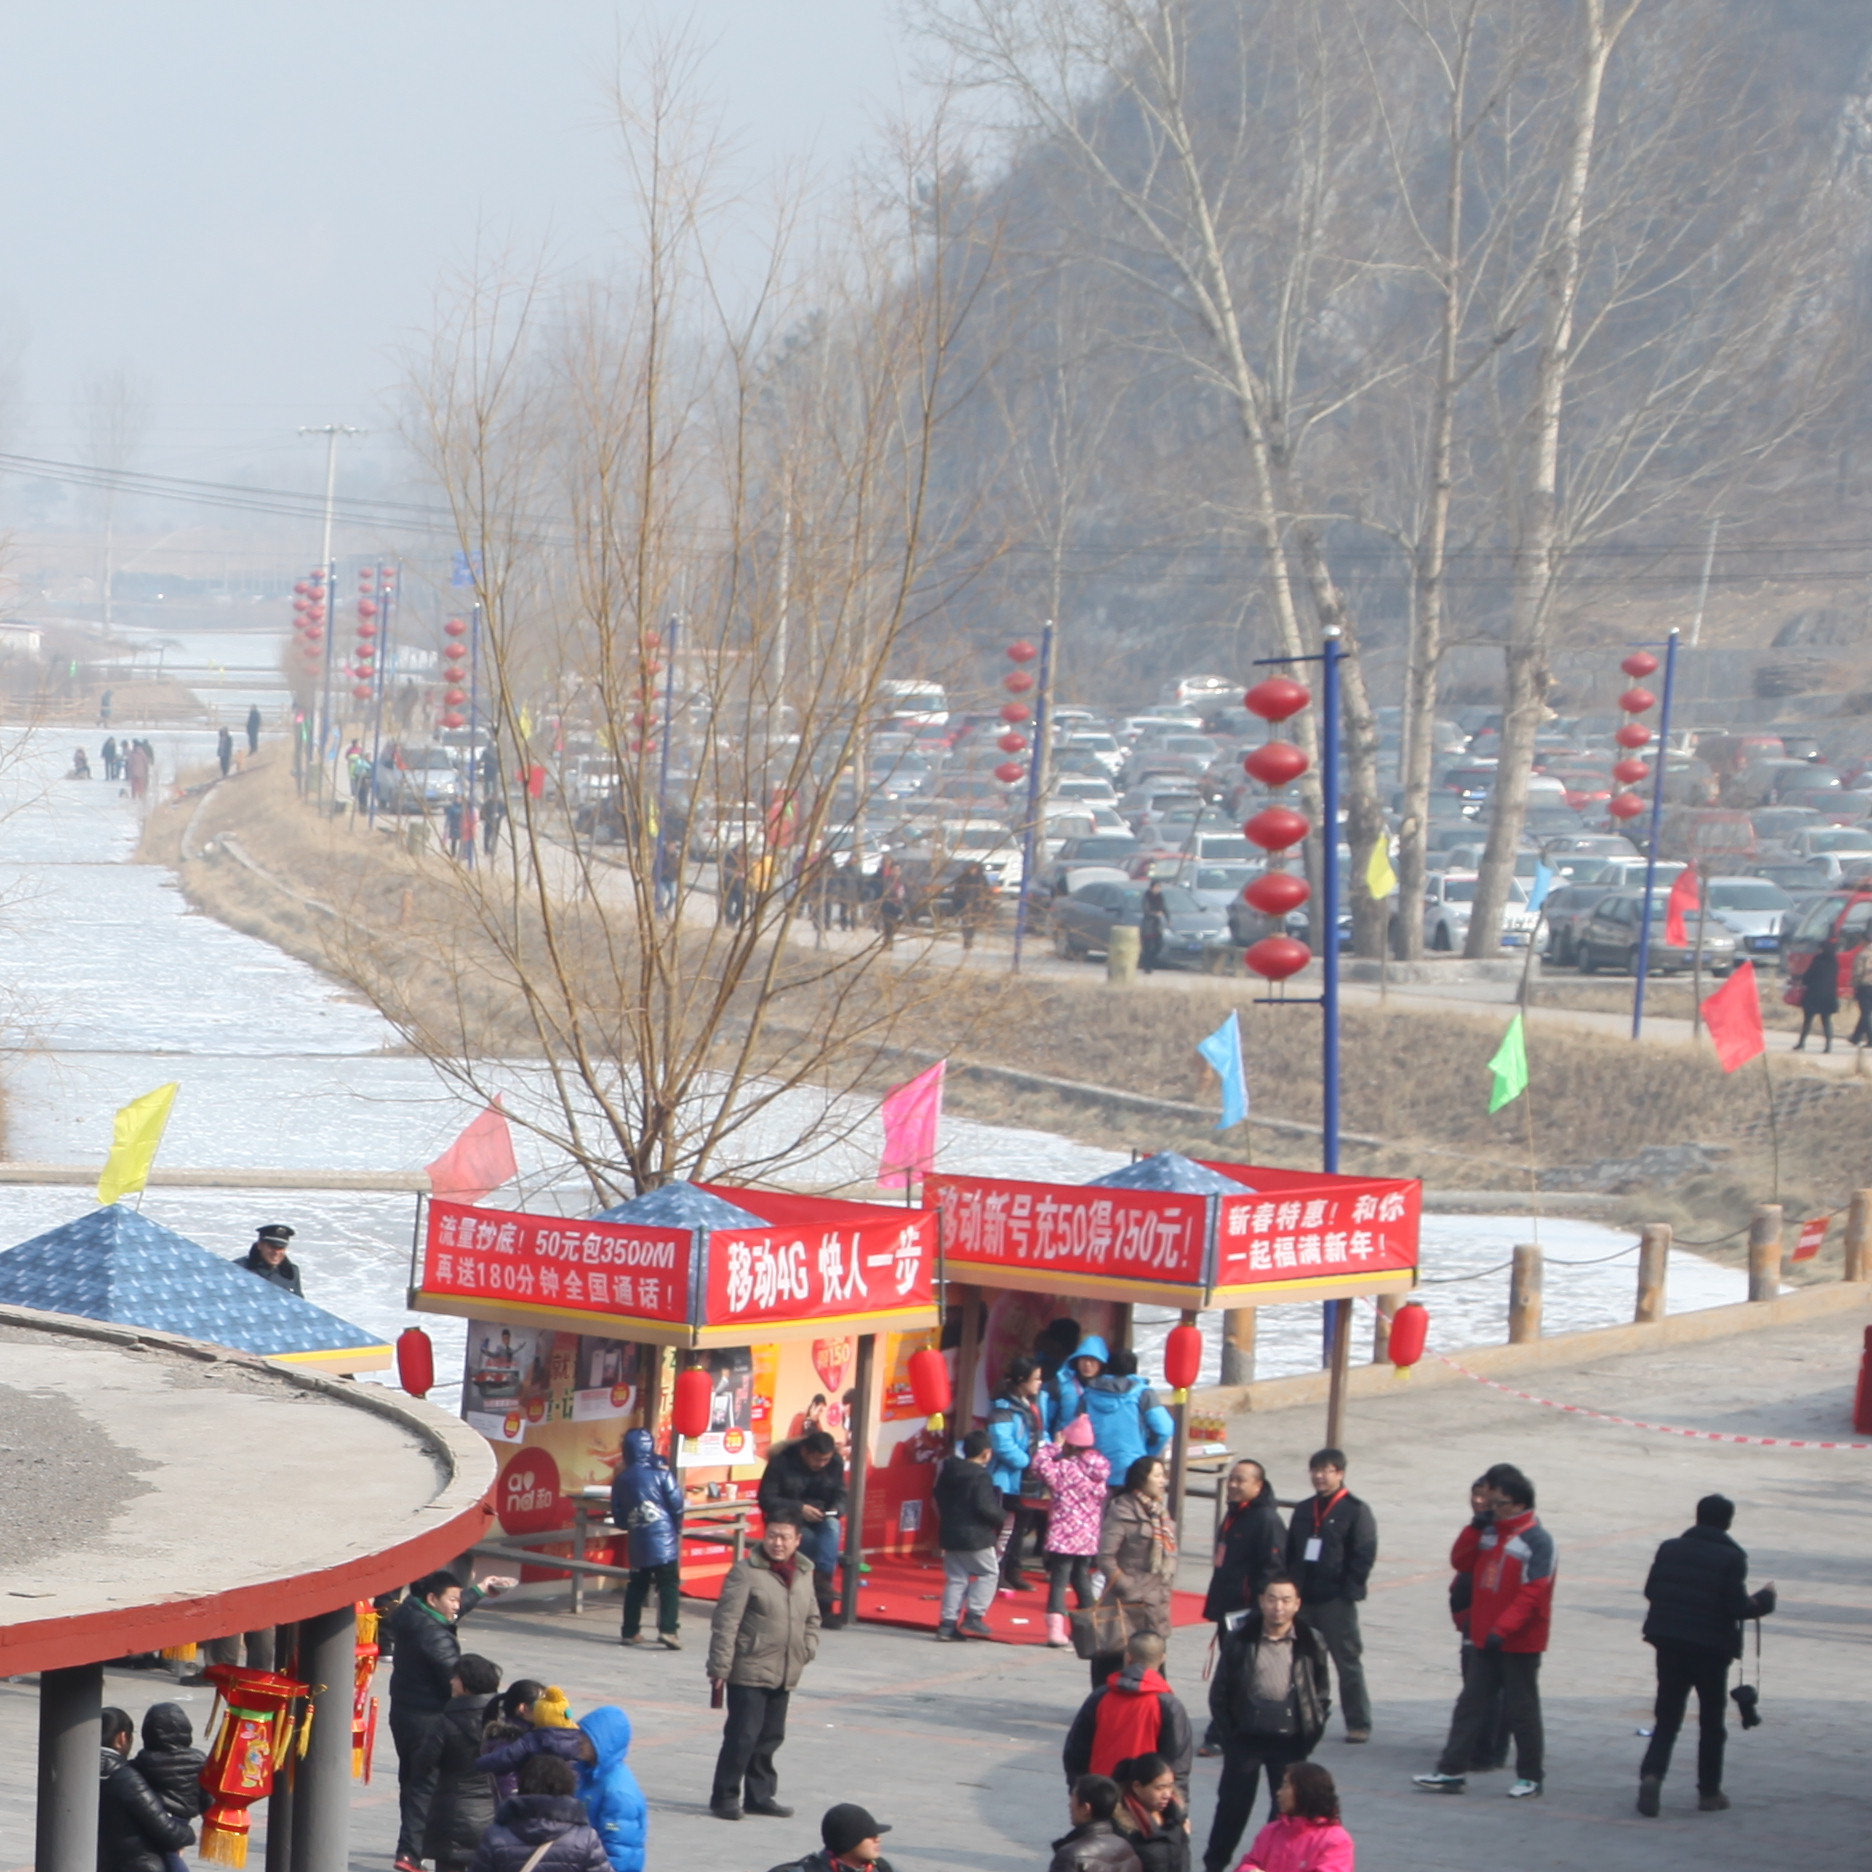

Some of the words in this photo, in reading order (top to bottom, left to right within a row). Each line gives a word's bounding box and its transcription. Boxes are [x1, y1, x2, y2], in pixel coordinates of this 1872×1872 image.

[726, 1238, 809, 1313] 移动4G
[818, 1225, 923, 1303] 快人一步
